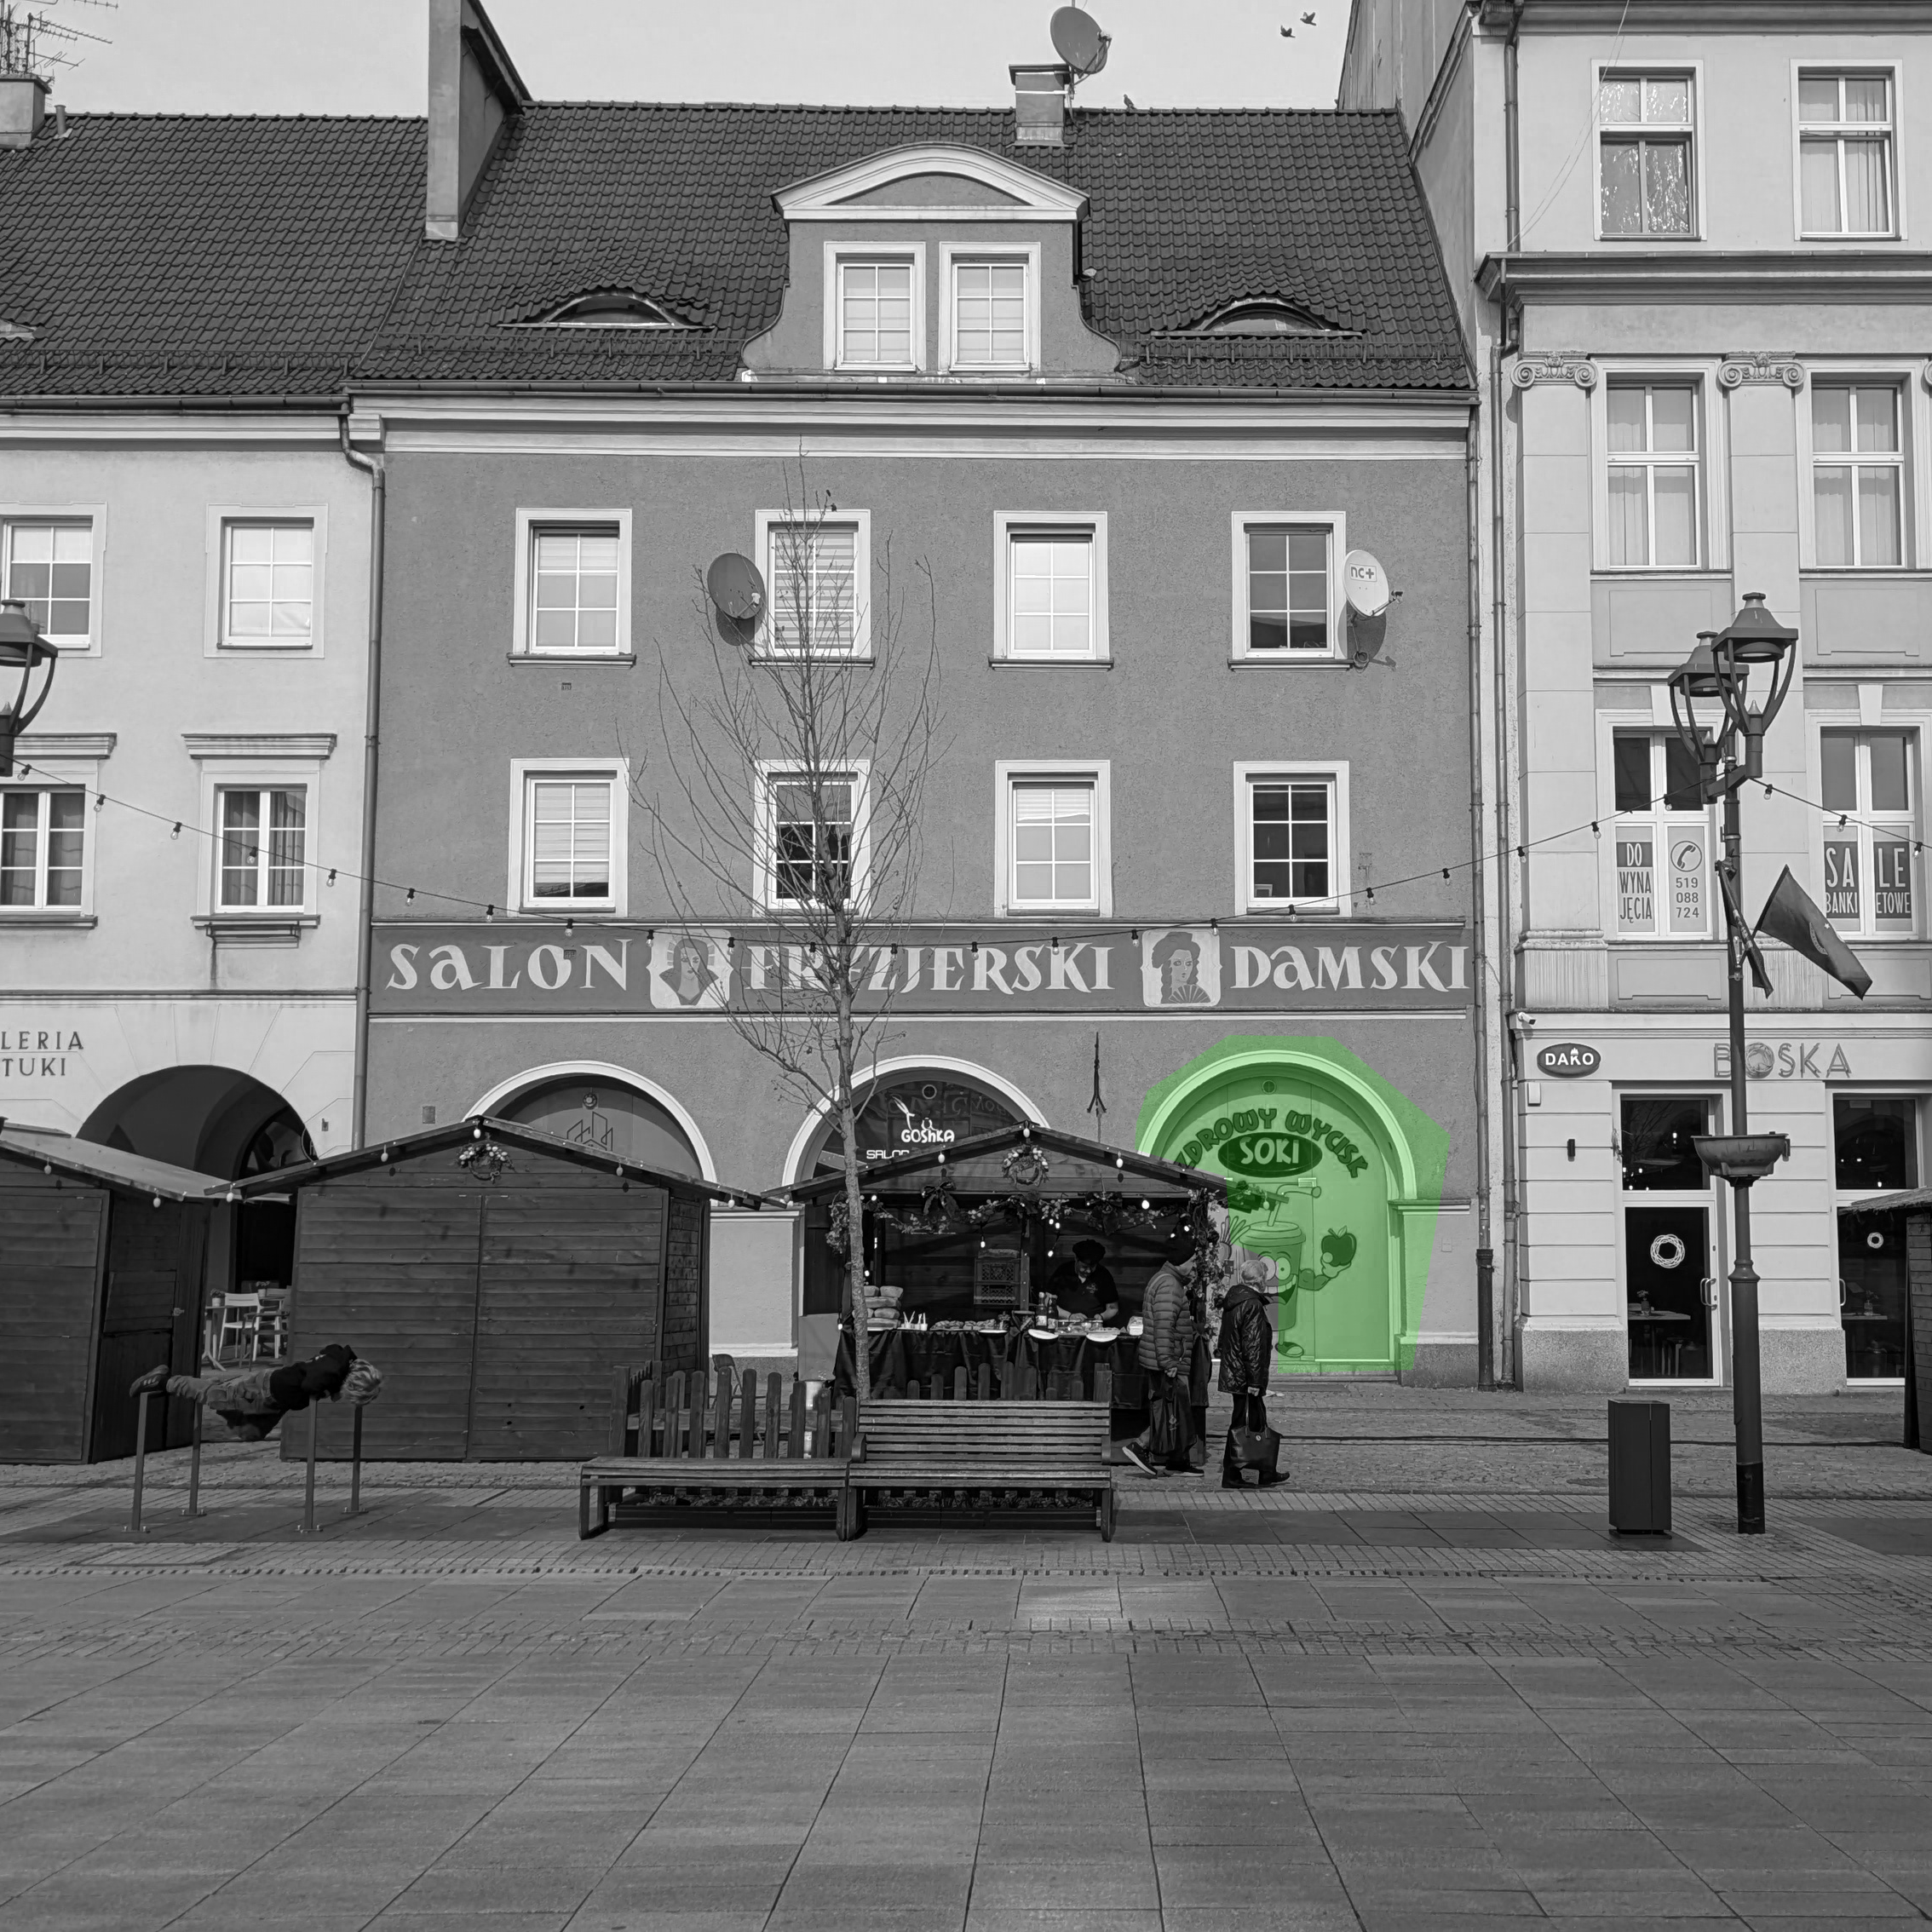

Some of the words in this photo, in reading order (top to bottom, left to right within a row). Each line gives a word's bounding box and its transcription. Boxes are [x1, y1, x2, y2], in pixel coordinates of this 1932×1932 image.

[1626, 842, 1642, 866] DO
[1619, 871, 1652, 894] WYNA
[1676, 877, 1699, 888] 519
[1676, 892, 1699, 904] 088
[1619, 897, 1653, 923] JĘCIA
[1676, 906, 1699, 918] 724
[1544, 1047, 1595, 1066] DAKO
[1239, 1136, 1300, 1165] SOKI
[1285, 1109, 1368, 1178] WYCISK
